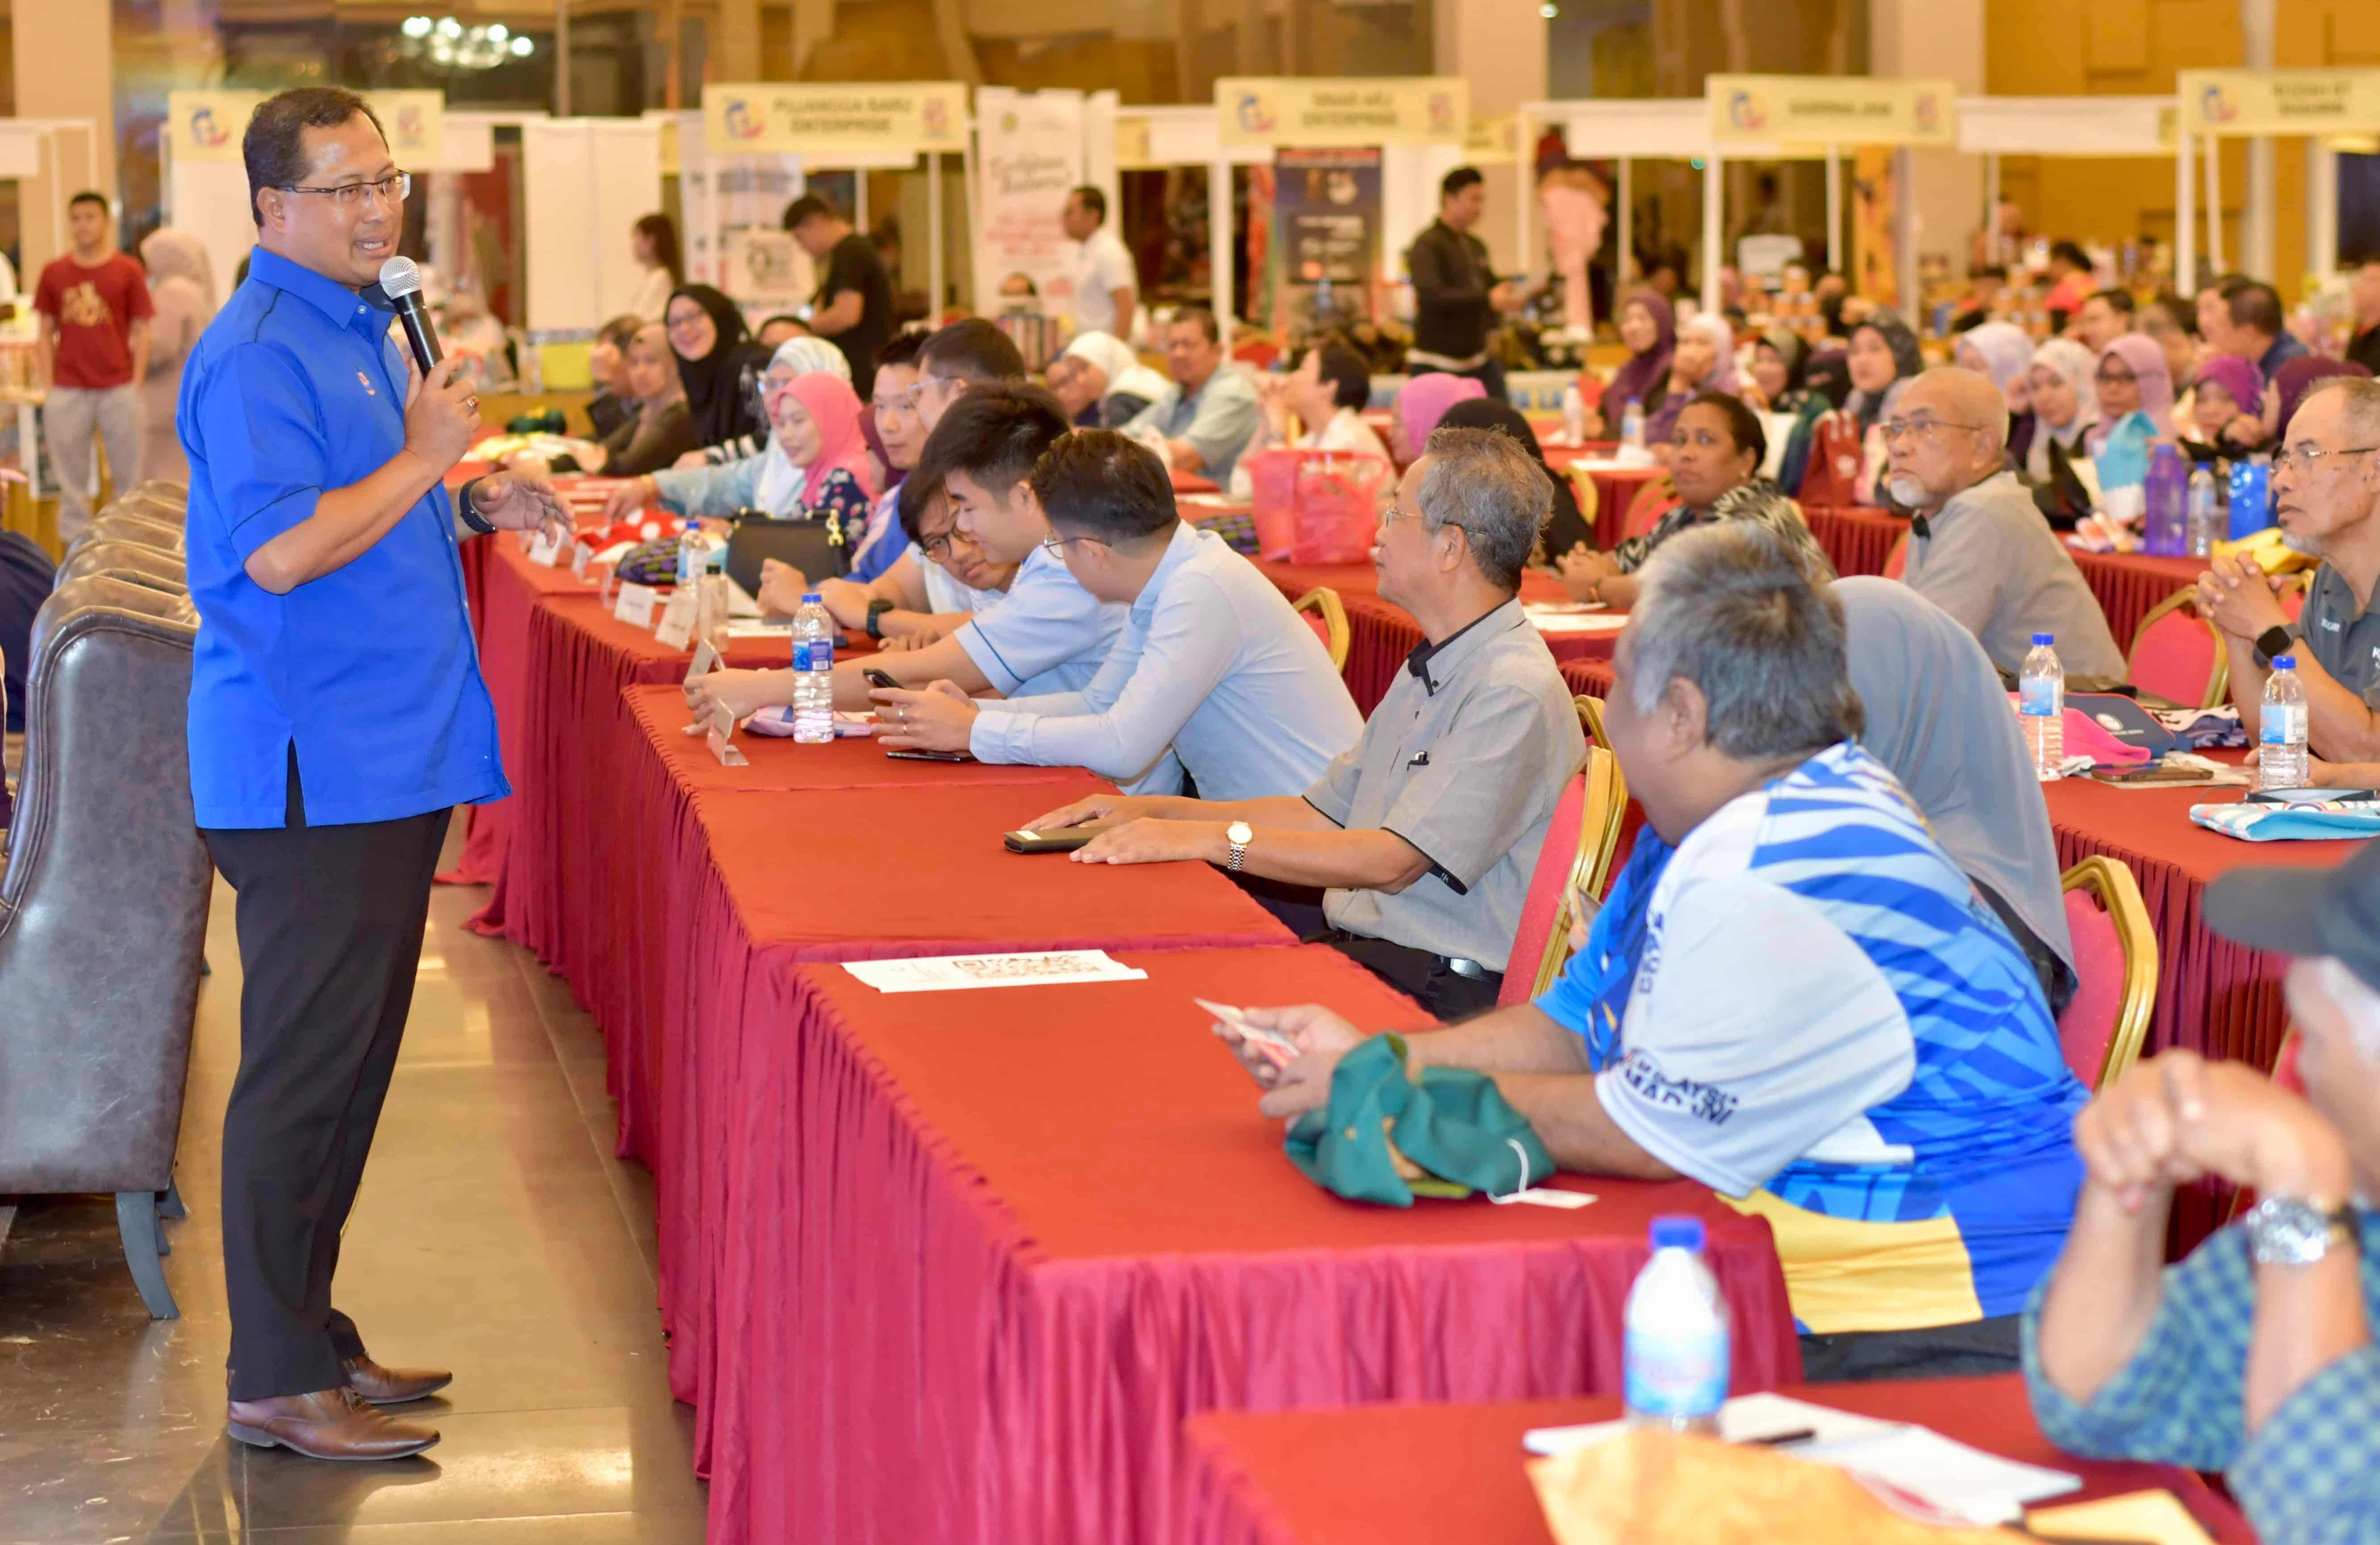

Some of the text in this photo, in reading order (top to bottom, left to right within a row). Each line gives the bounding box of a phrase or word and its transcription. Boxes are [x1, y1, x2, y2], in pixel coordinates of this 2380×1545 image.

[868, 98, 913, 113] BARU
[791, 118, 890, 133] ENTERPRISE
[1302, 112, 1397, 126] ENTERPRISE
